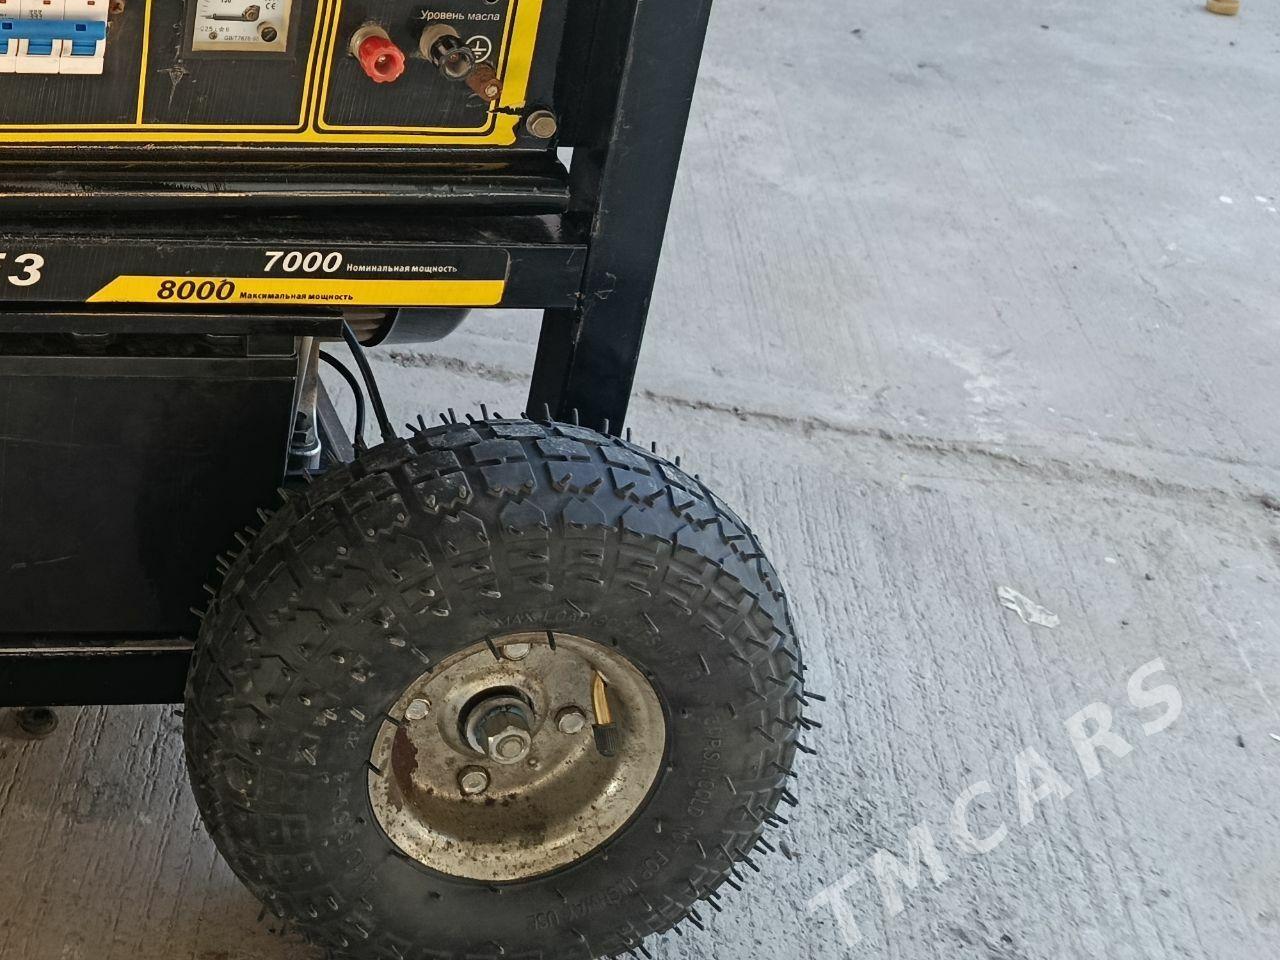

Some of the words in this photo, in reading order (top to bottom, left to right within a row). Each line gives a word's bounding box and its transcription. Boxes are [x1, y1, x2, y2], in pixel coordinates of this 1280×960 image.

[420, 9, 465, 21] Уровень
[467, 12, 500, 21] масла
[263, 251, 343, 273] 7000
[346, 263, 410, 273] Номинальная
[411, 265, 458, 274] мощность
[156, 279, 236, 301] 8000
[239, 291, 307, 300] Максимальная
[308, 293, 354, 302] мощность
